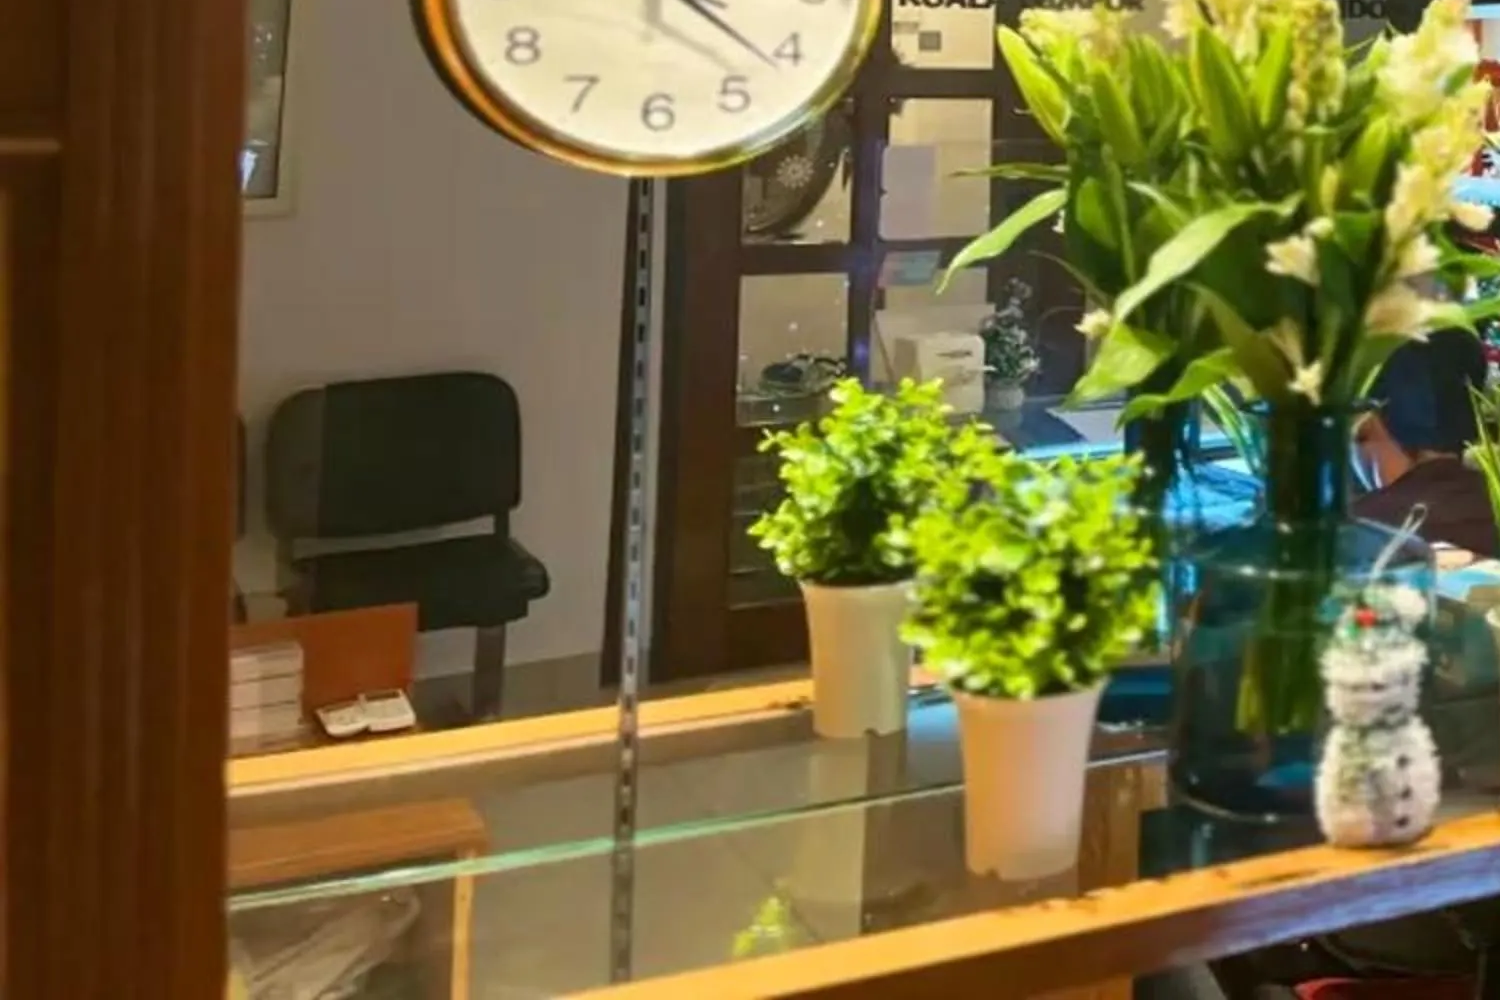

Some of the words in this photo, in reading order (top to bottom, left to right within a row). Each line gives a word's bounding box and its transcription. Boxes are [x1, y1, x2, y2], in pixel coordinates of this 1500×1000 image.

[504, 26, 541, 66] 8
[773, 32, 803, 66] 4
[564, 75, 601, 115] 7
[640, 93, 677, 132] 6
[717, 76, 752, 113] 5
